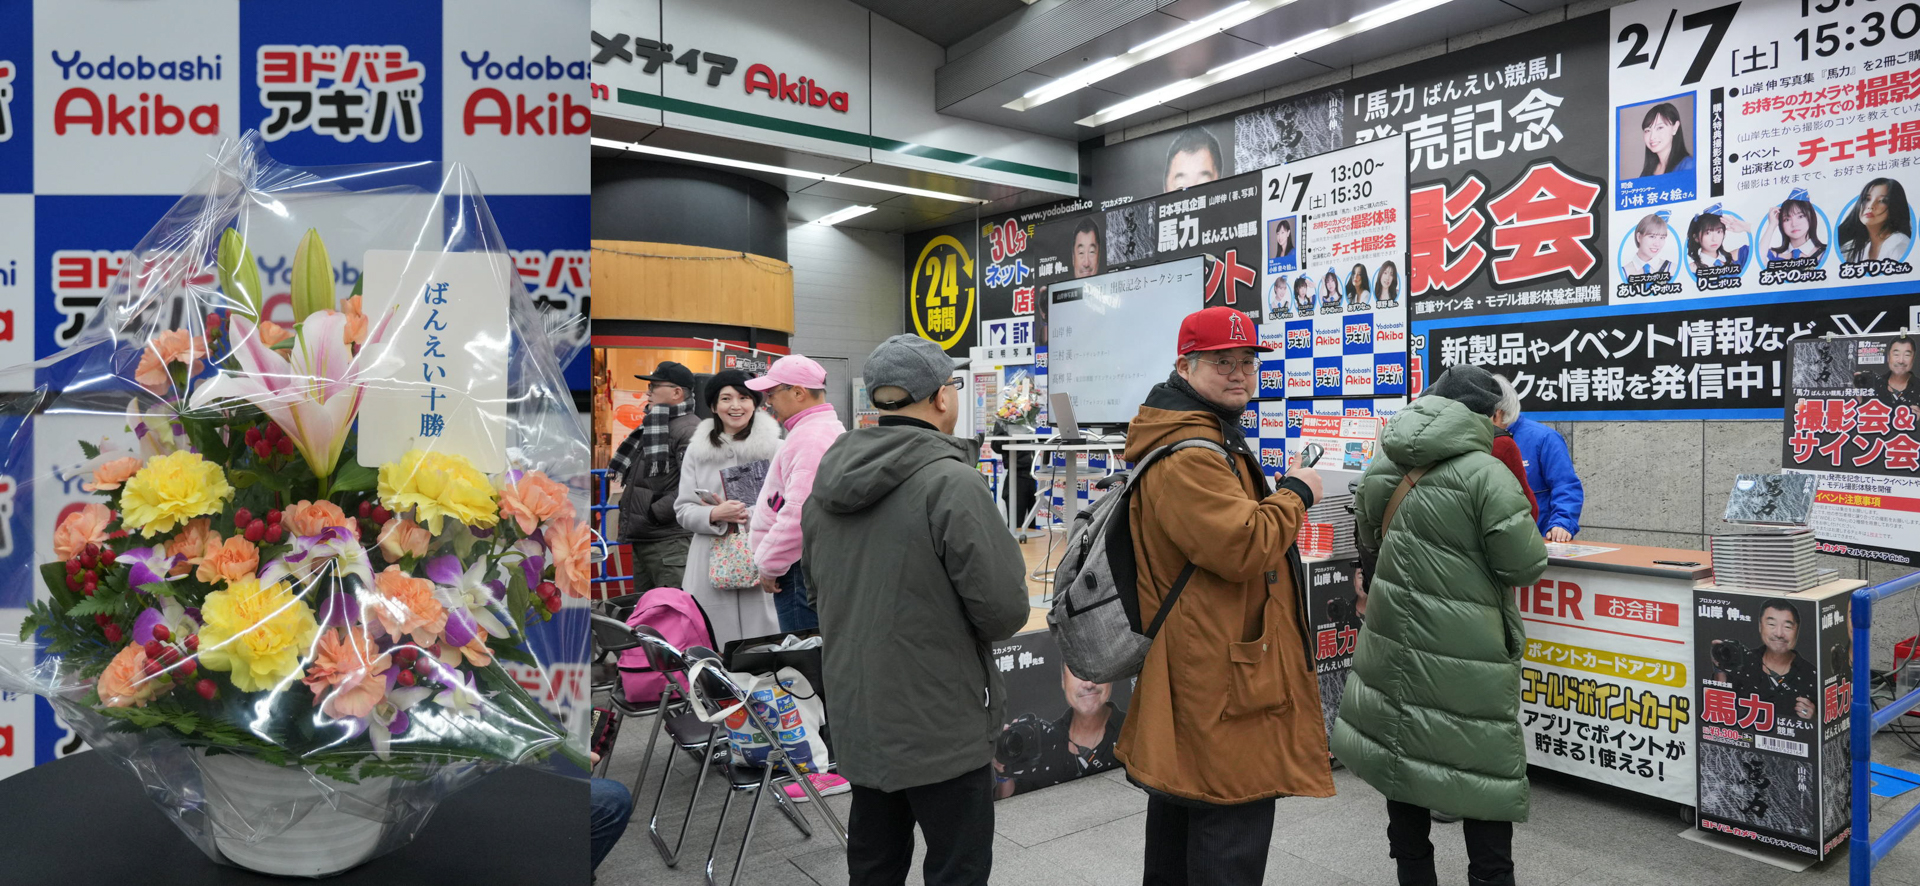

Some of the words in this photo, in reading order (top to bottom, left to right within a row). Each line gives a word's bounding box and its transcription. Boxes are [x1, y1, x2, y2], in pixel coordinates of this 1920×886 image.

[1616, 1, 1743, 87] 2/7
[1731, 40, 1779, 78] [土]
[1793, 3, 1920, 62] 15:30
[51, 50, 222, 81] Yodobashi
[261, 50, 419, 84] ヨドバシ
[590, 30, 739, 87] メディア
[744, 63, 849, 113] Akiba
[1352, 83, 1416, 123] 「馬力
[1421, 52, 1564, 108] ばんえい競馬」
[1741, 82, 1763, 97] 山岸
[1765, 80, 1778, 92] 伸
[1779, 72, 1815, 88] 写真集
[53, 87, 220, 136] Akiba
[265, 89, 418, 135] アキバ
[1741, 83, 1855, 116] お持ちのカメラや
[1780, 99, 1854, 124] スマホでの
[1741, 146, 1780, 162] イベント
[1741, 159, 1794, 177] 出演者との
[1100, 195, 1134, 210] プロカメラマン
[1267, 171, 1314, 213] 2/7
[1330, 179, 1373, 206] 15:30
[1620, 193, 1646, 209] 小林
[1647, 188, 1695, 206] 奈々絵さん
[1159, 195, 1206, 219] 日本写真企画
[1350, 207, 1397, 231] 撮影体験
[990, 217, 1028, 264] 30分
[1157, 214, 1199, 252] 馬力
[1201, 220, 1258, 245] ばんえい競馬
[1331, 233, 1397, 257] チェキ撮影会
[925, 253, 959, 308] 24
[985, 258, 1030, 289] ネット
[1760, 268, 1826, 286] あやのポリス
[1840, 260, 1911, 279] あずりなさん
[1697, 276, 1741, 291] りこポリス
[927, 306, 957, 333] 時間
[1315, 335, 1340, 346] Akiba
[1376, 330, 1404, 341] Akiba
[1440, 316, 1817, 367] 新製品やイベント情報など
[419, 281, 449, 437] ばんえい十勝
[1287, 377, 1311, 388] Akiba
[1345, 374, 1371, 385] Akiba
[1792, 387, 1810, 398] 「馬力
[1261, 418, 1284, 428] Akiba
[1788, 433, 1920, 472] サイン会
[1815, 492, 1881, 508] イベント注意事項
[1607, 597, 1664, 622] お会計
[1697, 605, 1723, 619] 山岸
[1698, 597, 1731, 606] プロカメラマン
[1315, 624, 1357, 661] 馬力
[995, 654, 1015, 673] 岸
[1527, 642, 1676, 682] ポイントカードアプリ
[1521, 668, 1690, 734] ゴールドポイントカード
[1700, 687, 1775, 732] 馬力
[1824, 677, 1851, 725] 馬力
[1523, 709, 1686, 761] アプリでポイントが
[1776, 717, 1814, 730] ばんえい
[1776, 726, 1796, 738] 競馬
[1535, 732, 1665, 782] 貯まる！使える！
[1701, 819, 1758, 840] ヨドバシカメラ
